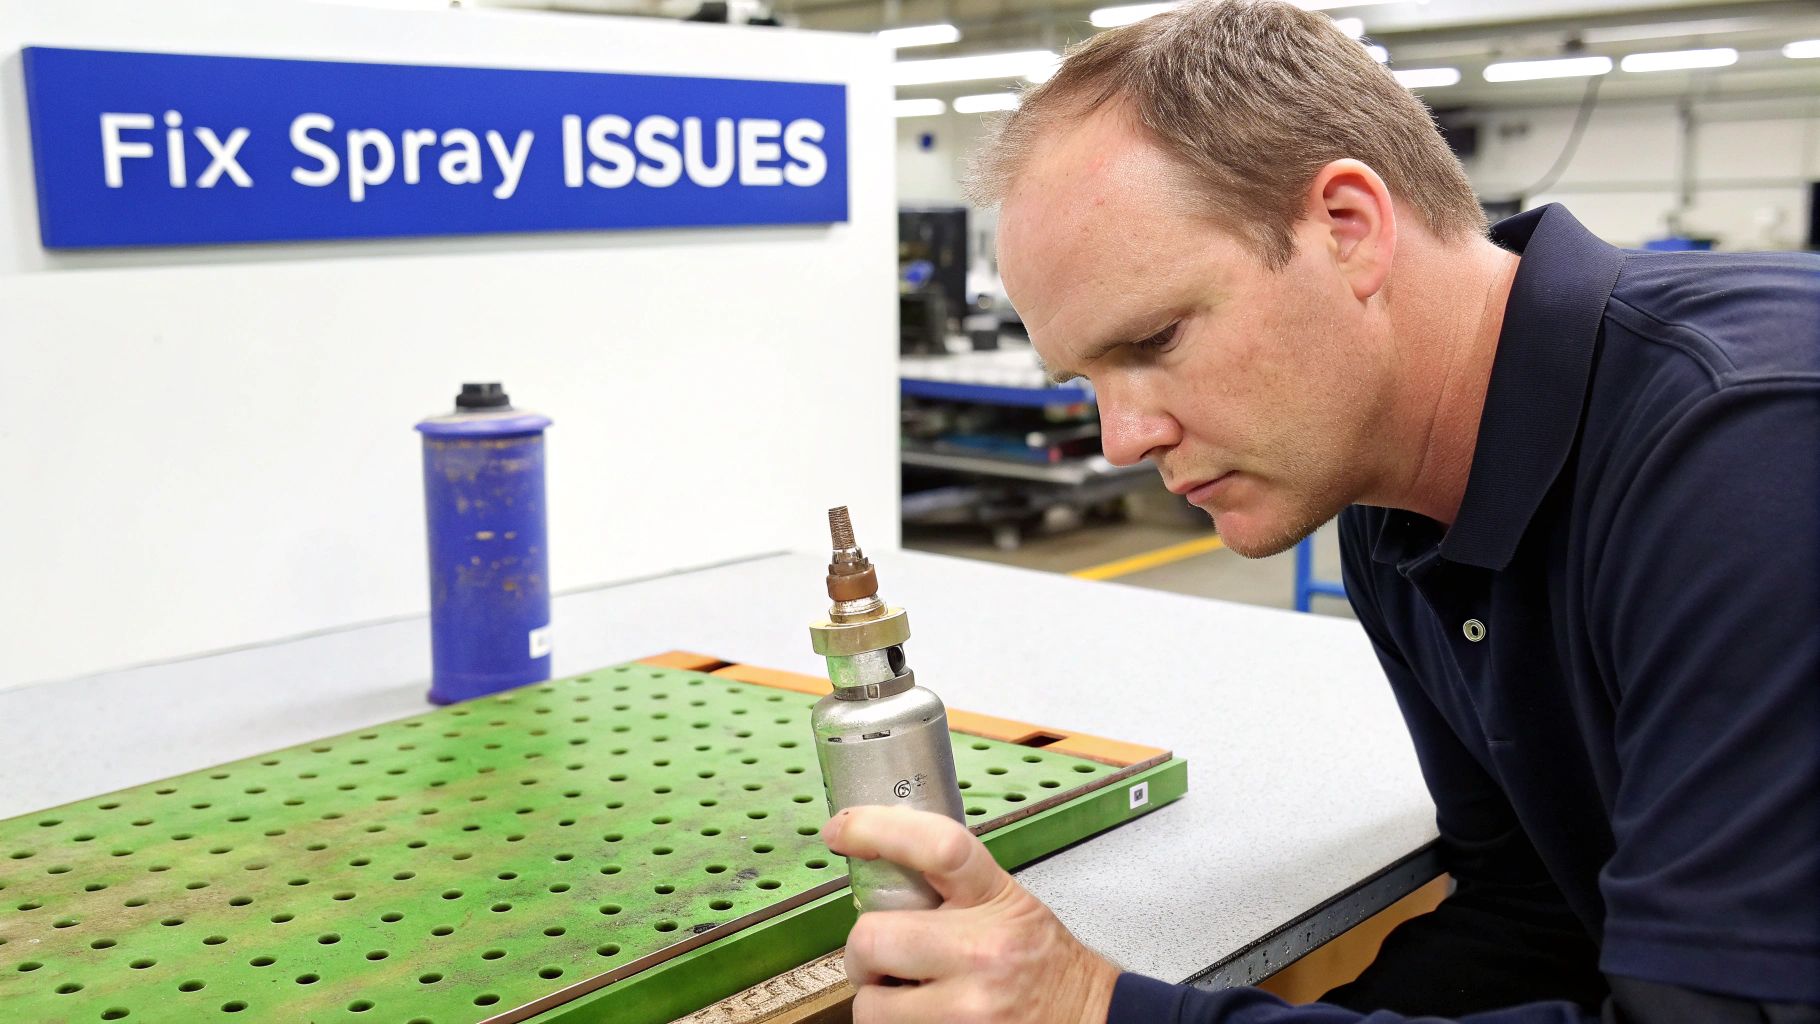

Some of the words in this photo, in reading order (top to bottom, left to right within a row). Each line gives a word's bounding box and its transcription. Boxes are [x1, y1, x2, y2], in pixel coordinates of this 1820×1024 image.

[100, 111, 252, 188] Fix
[290, 114, 534, 201] Spray
[563, 115, 828, 189] ISSUES
